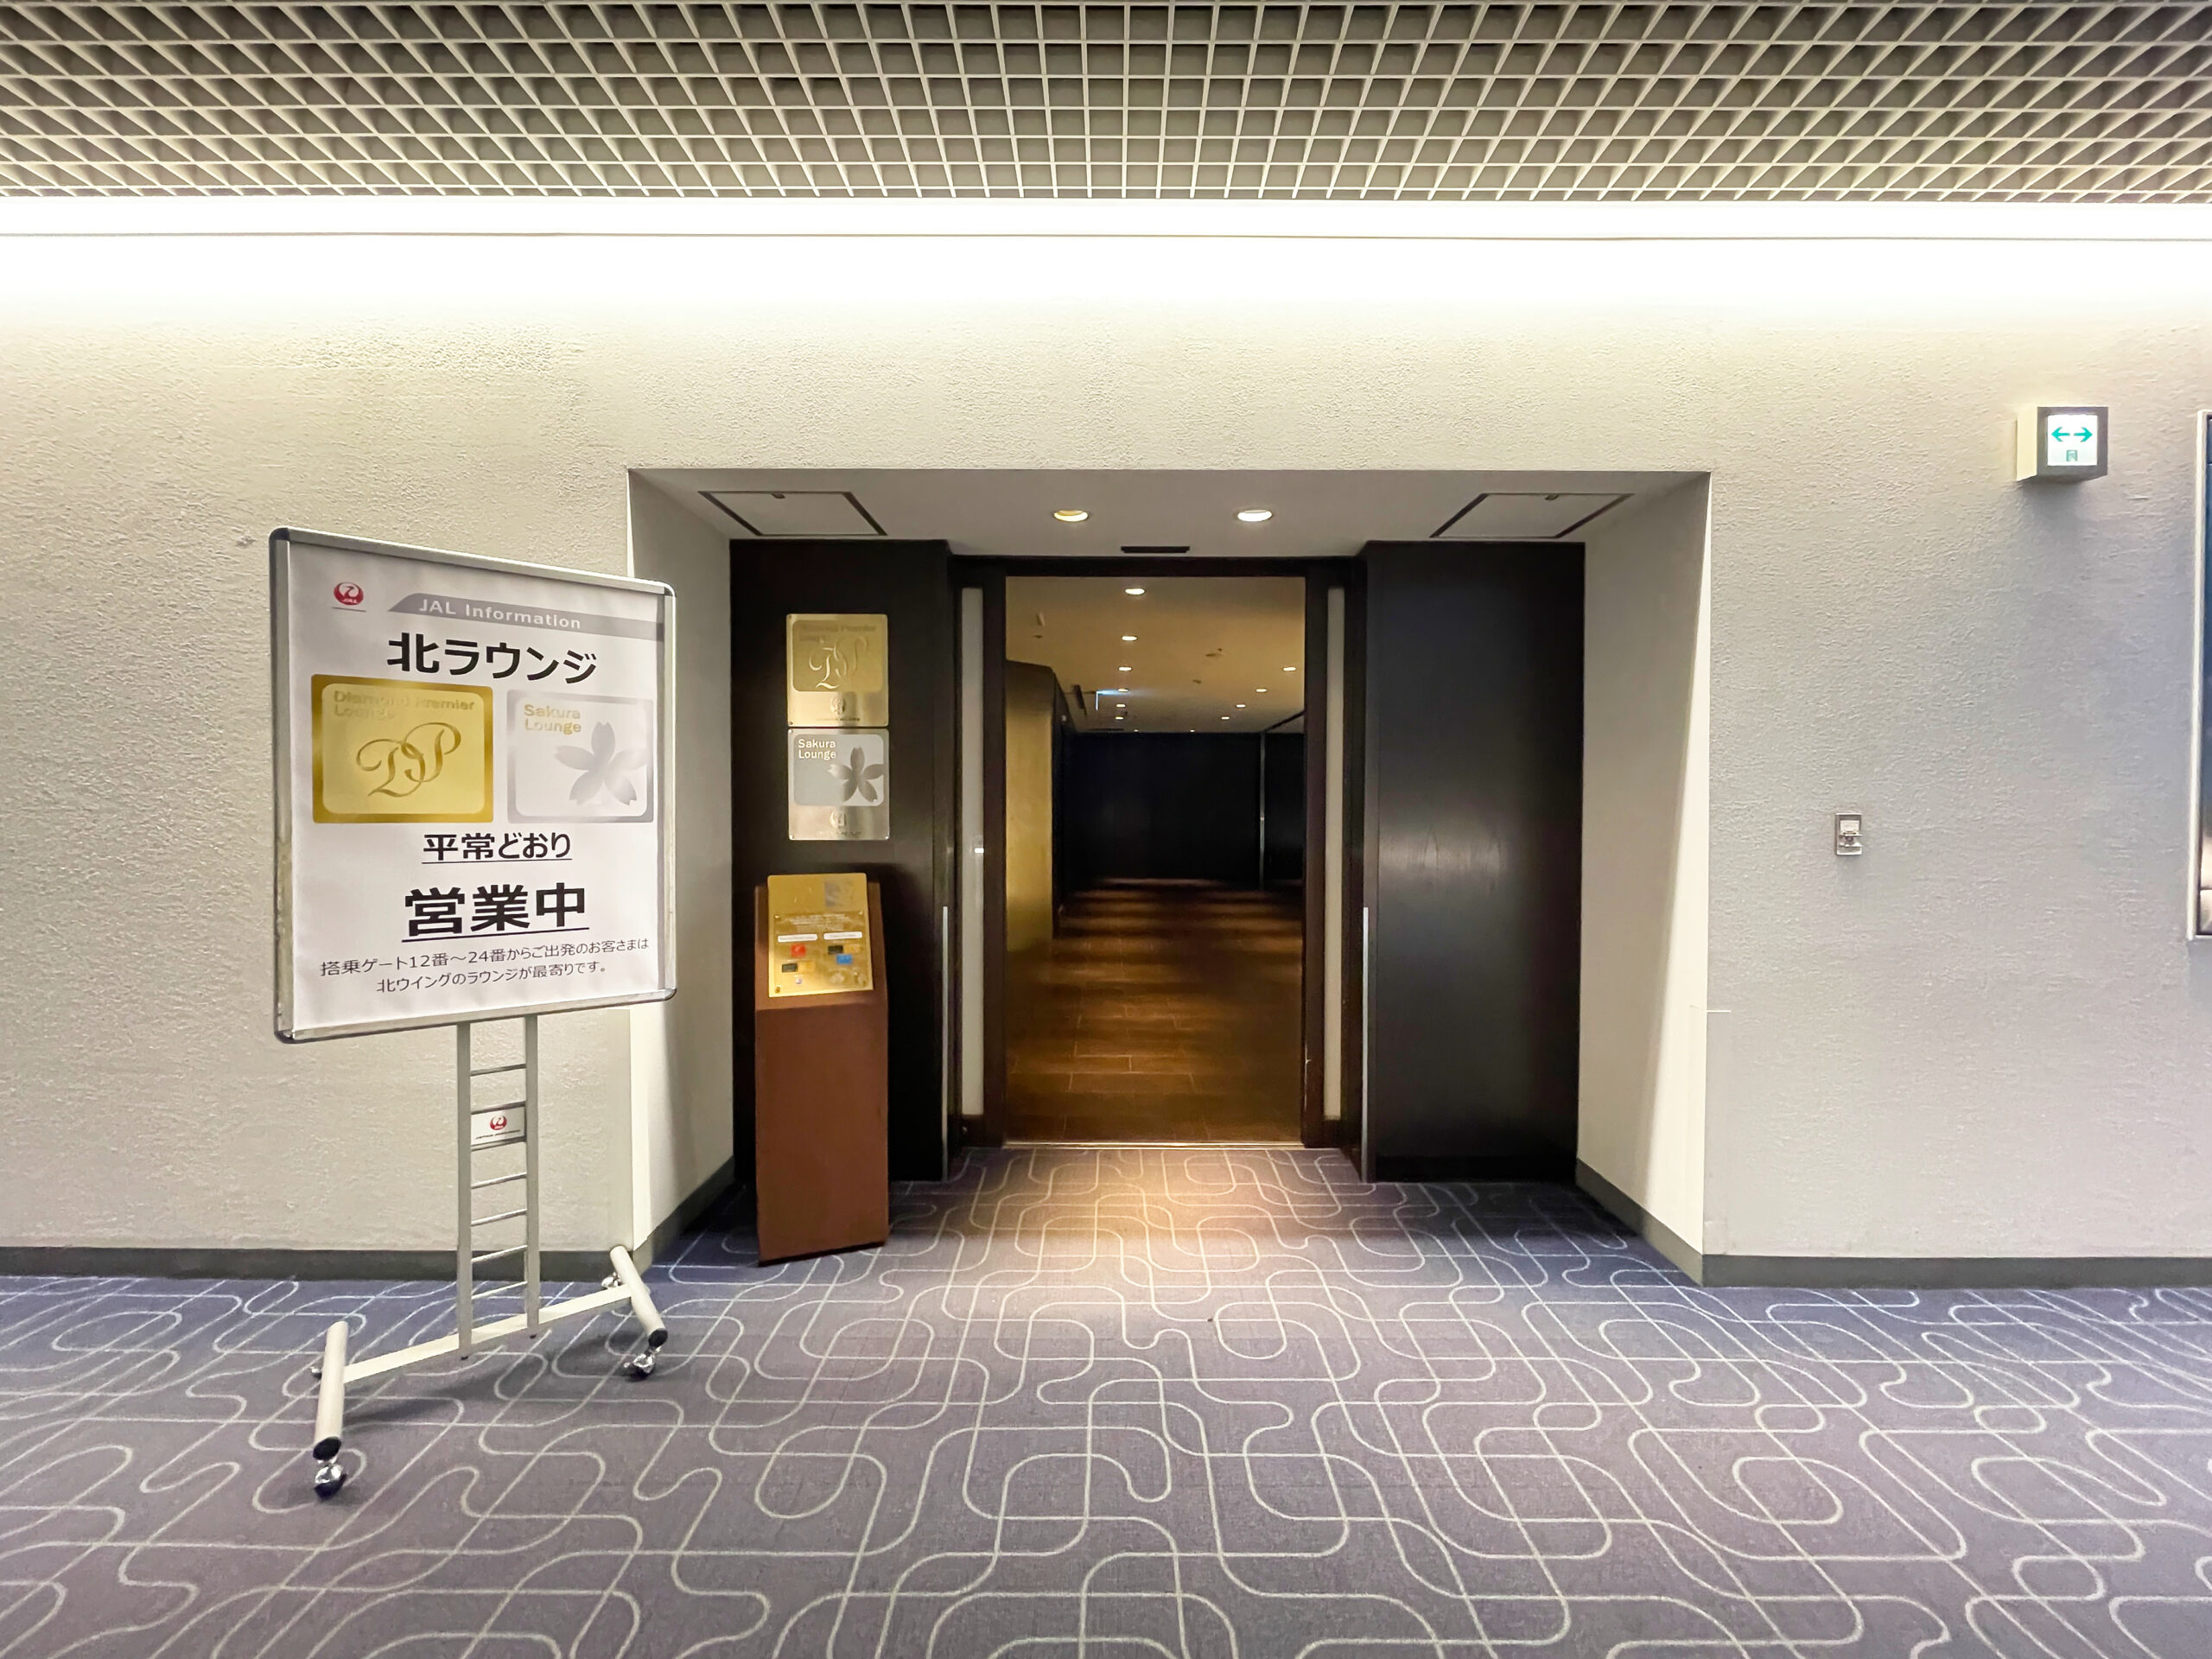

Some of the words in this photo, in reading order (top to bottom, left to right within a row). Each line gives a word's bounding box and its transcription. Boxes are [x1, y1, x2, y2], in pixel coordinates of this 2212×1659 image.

[419, 599, 456, 614] JAL
[466, 604, 581, 629] Information
[387, 632, 597, 683] 北ラウンジ
[524, 704, 581, 719] Sakura
[524, 718, 582, 734] Lounge
[798, 739, 836, 748] Sakura
[798, 749, 836, 760] Lounge
[423, 832, 570, 861] 平常どおり
[405, 882, 586, 936] 営業中
[377, 961, 606, 993] 北ウイングのラウンジが最寄りです。
